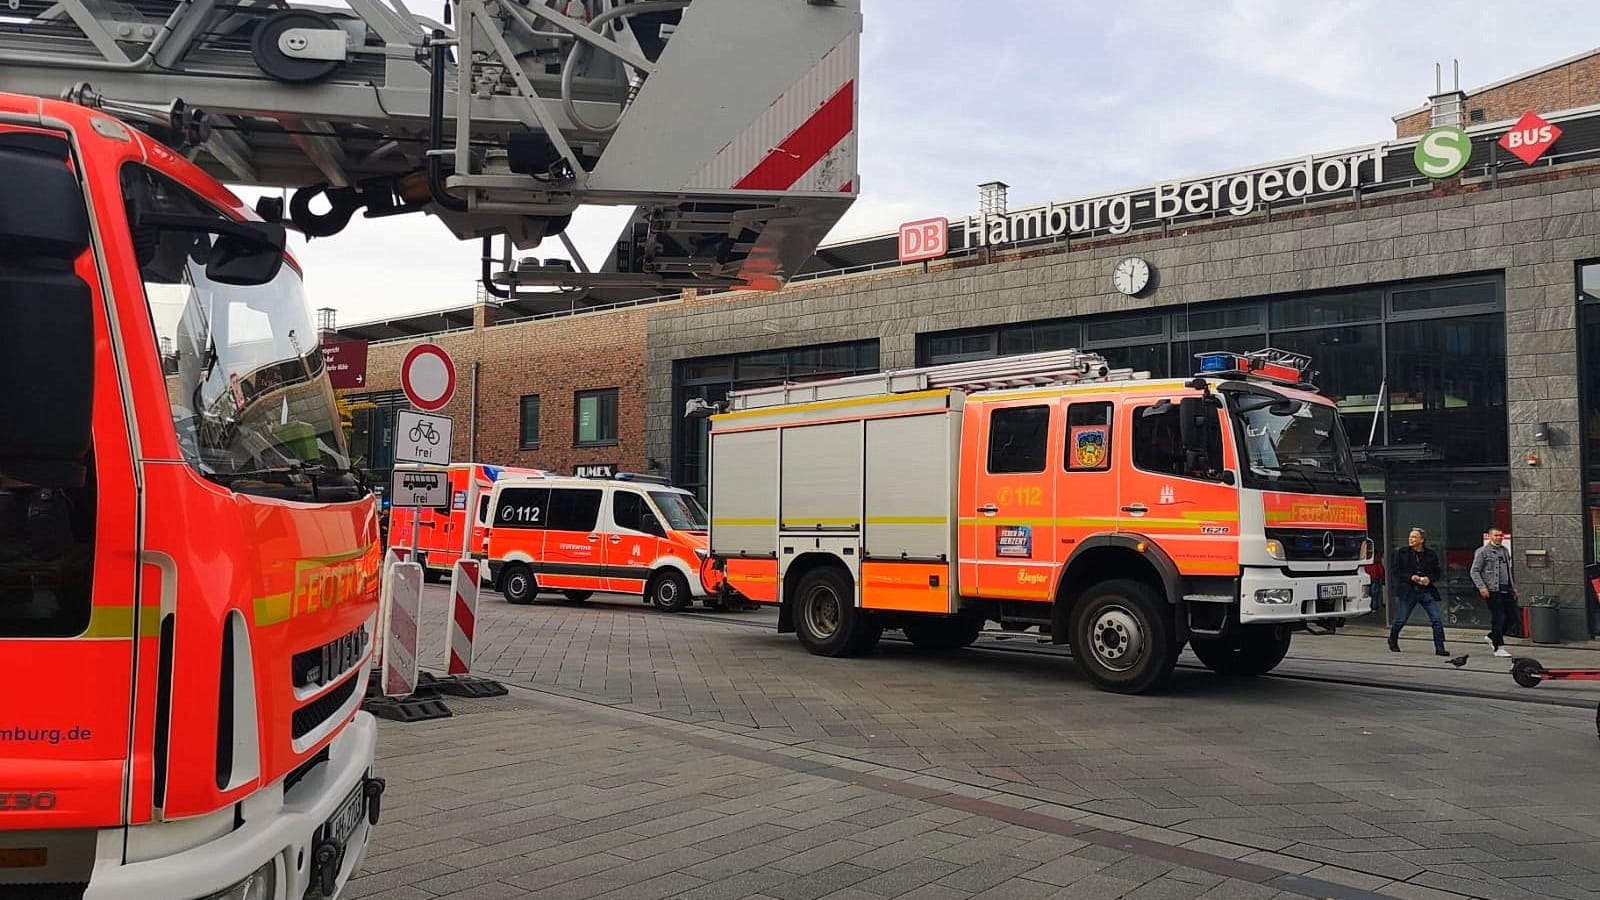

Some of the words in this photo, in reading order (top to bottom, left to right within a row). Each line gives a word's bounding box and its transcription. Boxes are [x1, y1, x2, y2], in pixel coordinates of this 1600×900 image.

[1508, 124, 1553, 148] BUS
[1423, 131, 1462, 174] S
[963, 143, 1389, 248] Hamburg-Bergedorf
[904, 224, 940, 254] DB
[415, 446, 433, 458] frei
[413, 493, 428, 504] frei
[1016, 486, 1042, 506] 112
[516, 506, 540, 521] 112
